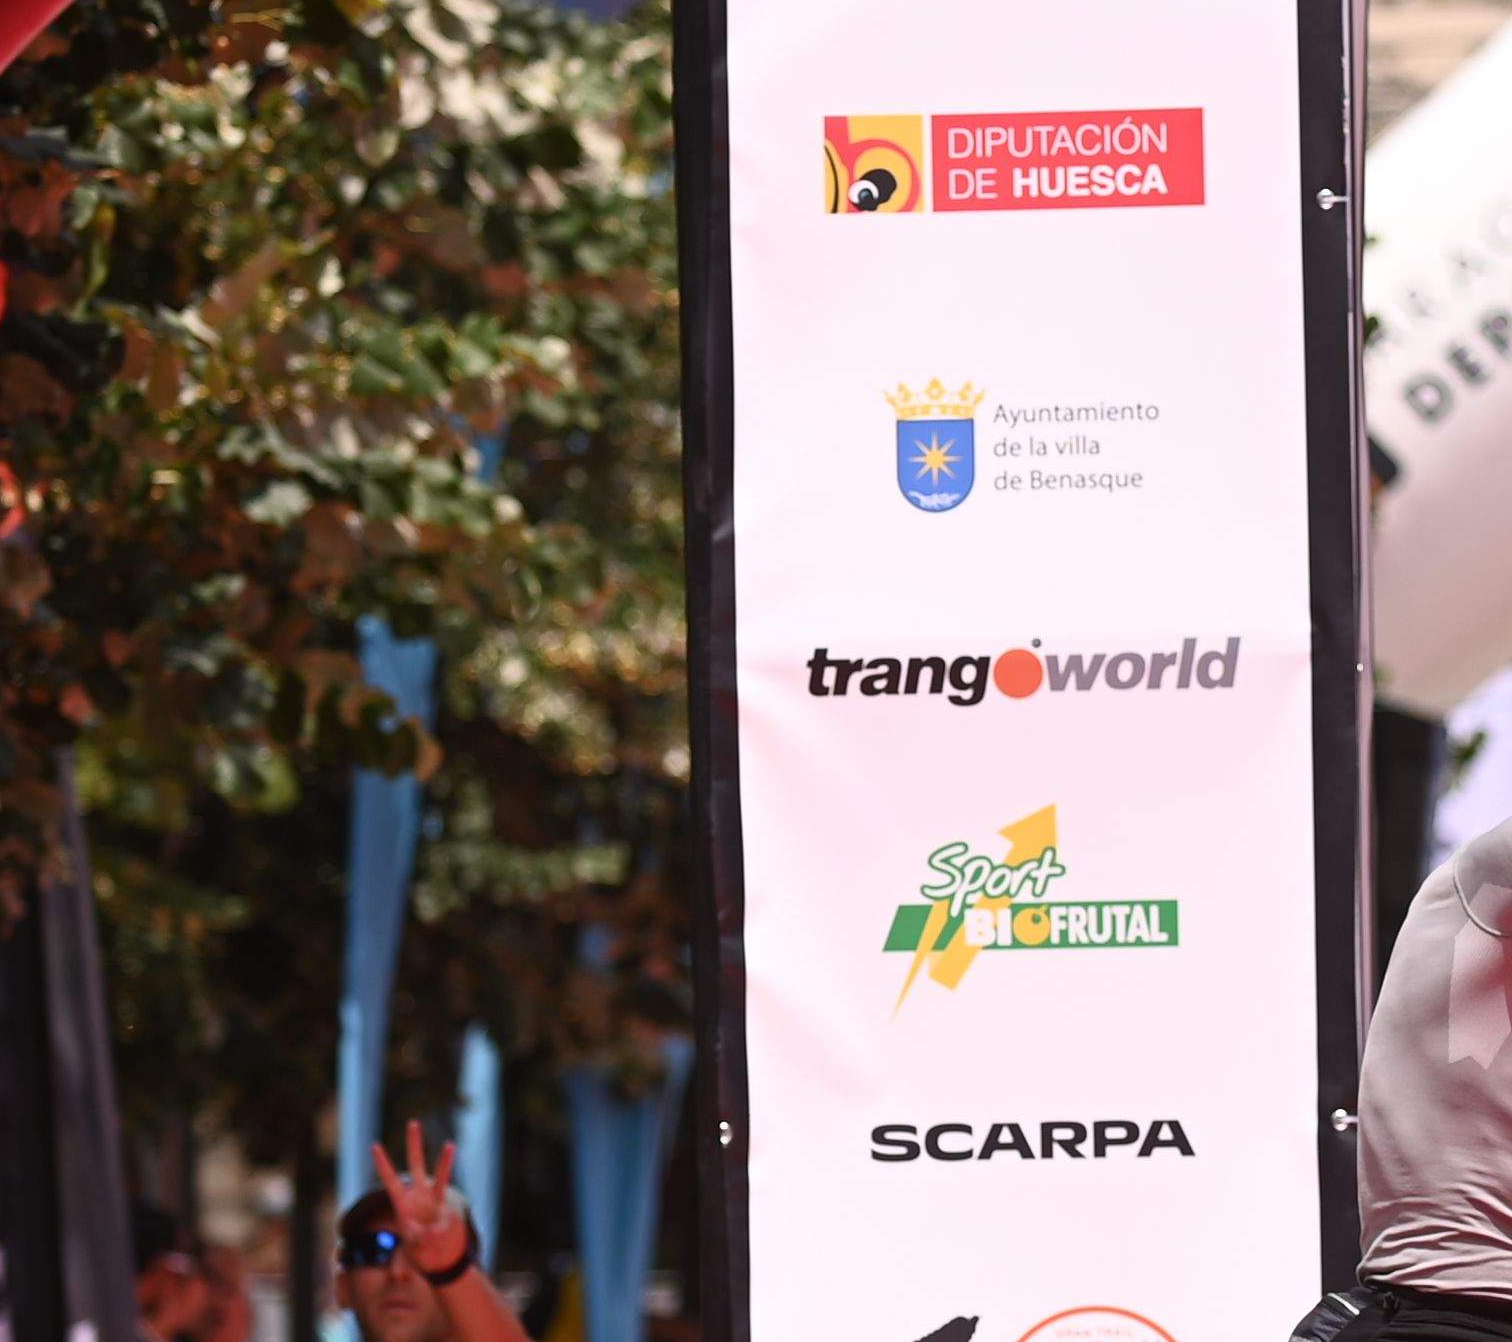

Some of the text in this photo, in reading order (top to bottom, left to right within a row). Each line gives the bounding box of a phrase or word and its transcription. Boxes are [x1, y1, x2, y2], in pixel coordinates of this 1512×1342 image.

[947, 116, 1169, 160] DIPUTACIÓN
[947, 163, 1169, 200] DE HUESCA
[993, 401, 1160, 427] Ayuntamiento
[993, 434, 1101, 458] de la villa
[993, 468, 1143, 493] de Benasque
[806, 636, 1241, 707] trangoworld
[920, 842, 1066, 917] Sport
[964, 903, 1170, 947] BIOFRUTAL
[870, 1120, 1196, 1162] SCARPA
